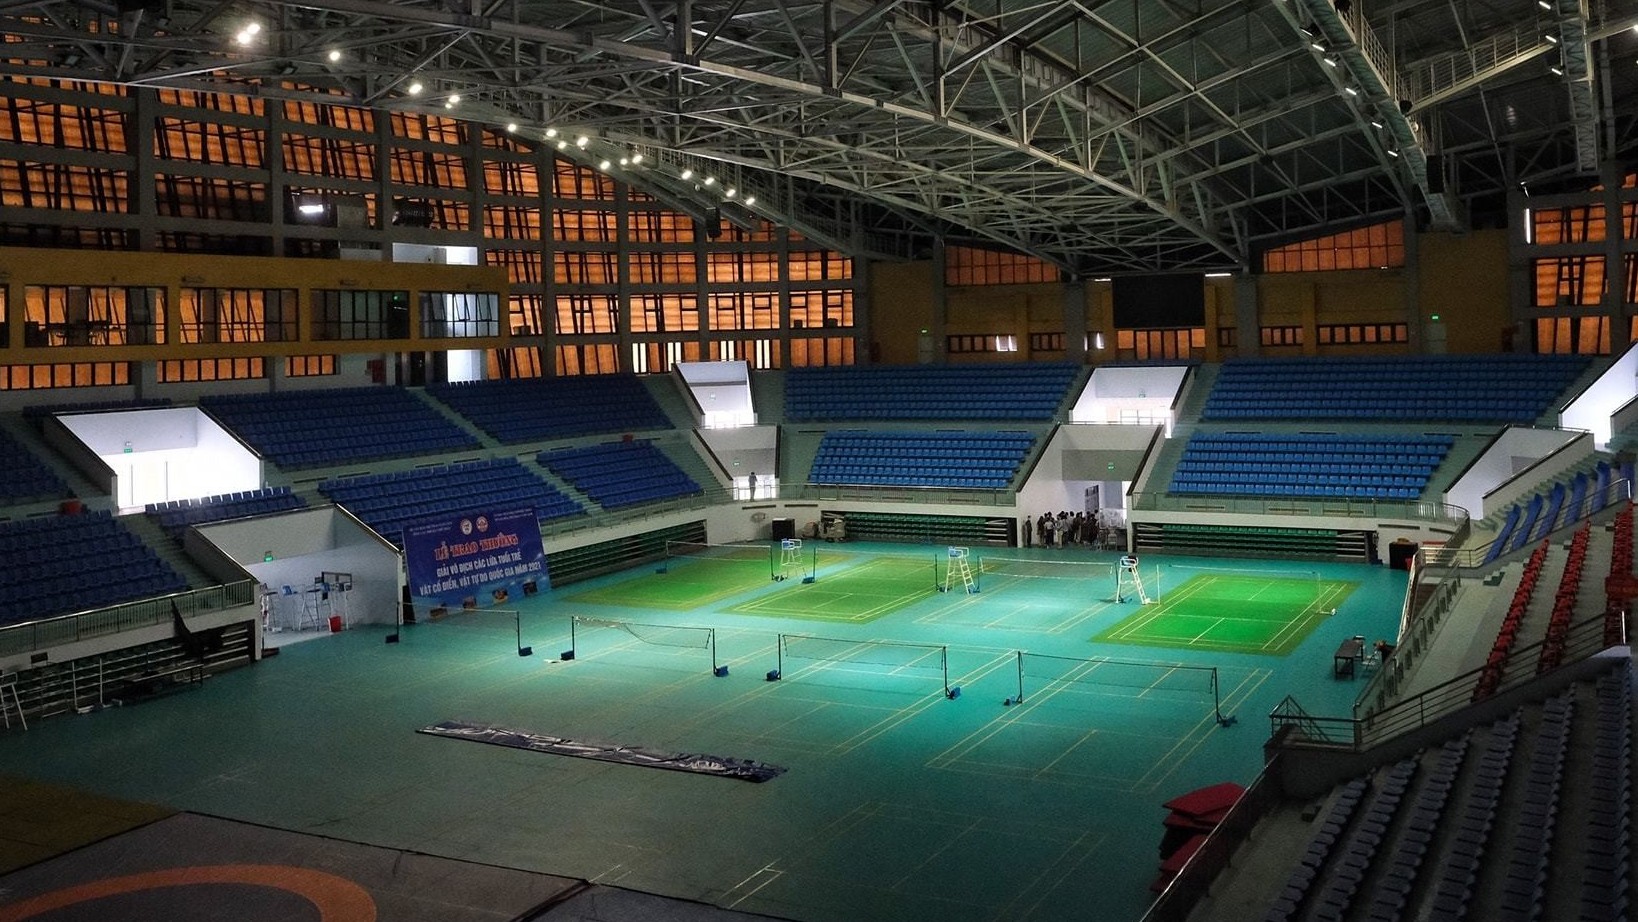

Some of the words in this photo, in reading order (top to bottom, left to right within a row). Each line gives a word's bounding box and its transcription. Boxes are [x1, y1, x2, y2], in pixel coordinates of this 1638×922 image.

[450, 541, 478, 557] TRAO
[480, 572, 488, 582] DO
[505, 566, 515, 577] GIA
[528, 561, 541, 571] 2021
